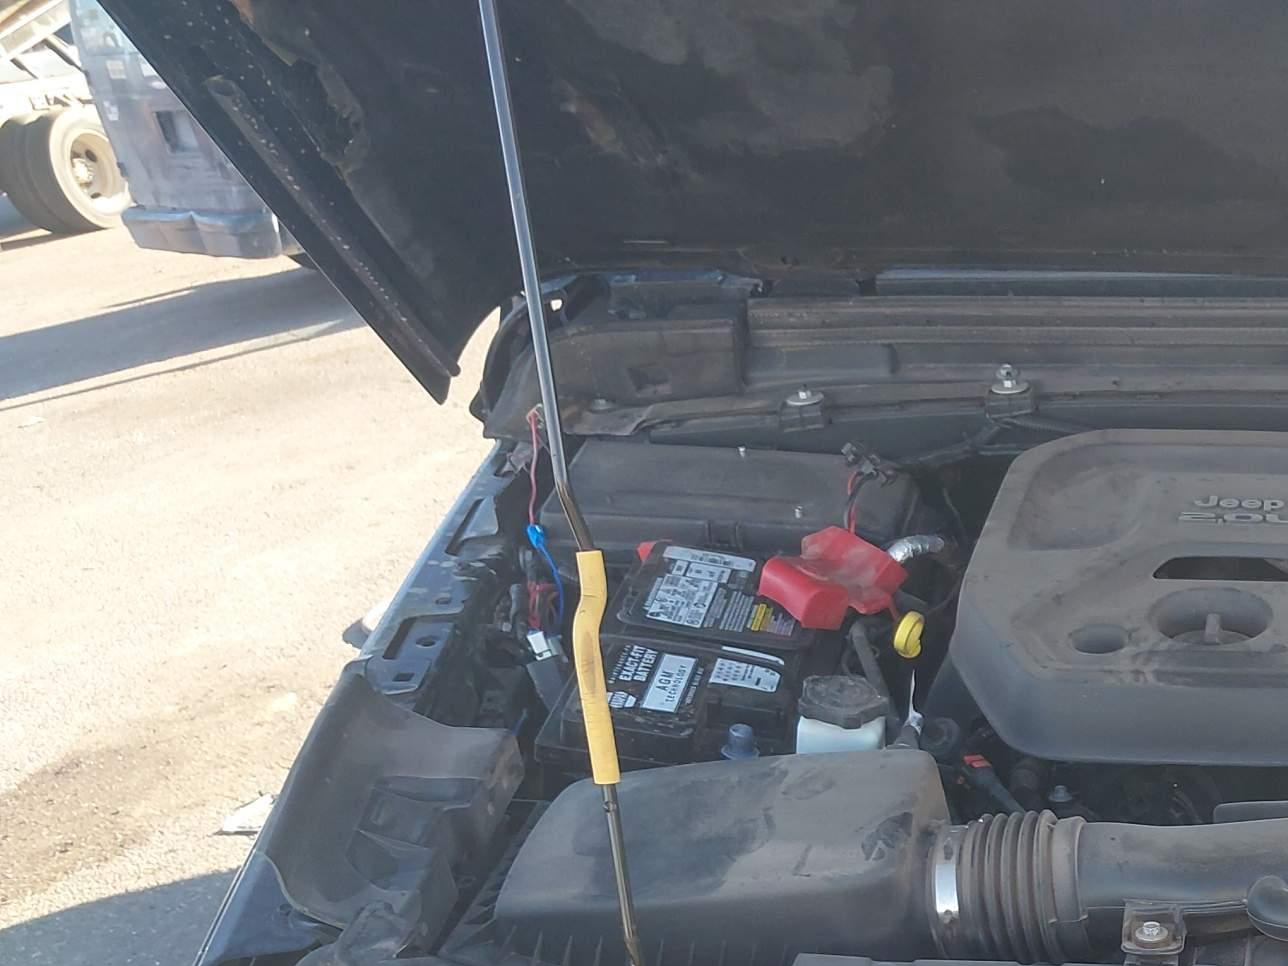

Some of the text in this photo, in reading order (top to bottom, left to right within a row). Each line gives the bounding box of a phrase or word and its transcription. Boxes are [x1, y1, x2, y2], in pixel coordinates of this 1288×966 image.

[1194, 496, 1285, 511] Jeep
[618, 645, 647, 681] EXACT-FIT
[633, 648, 659, 682] BATTERY
[655, 671, 673, 691] AGM
[665, 664, 687, 703] TECHNOLOGY
